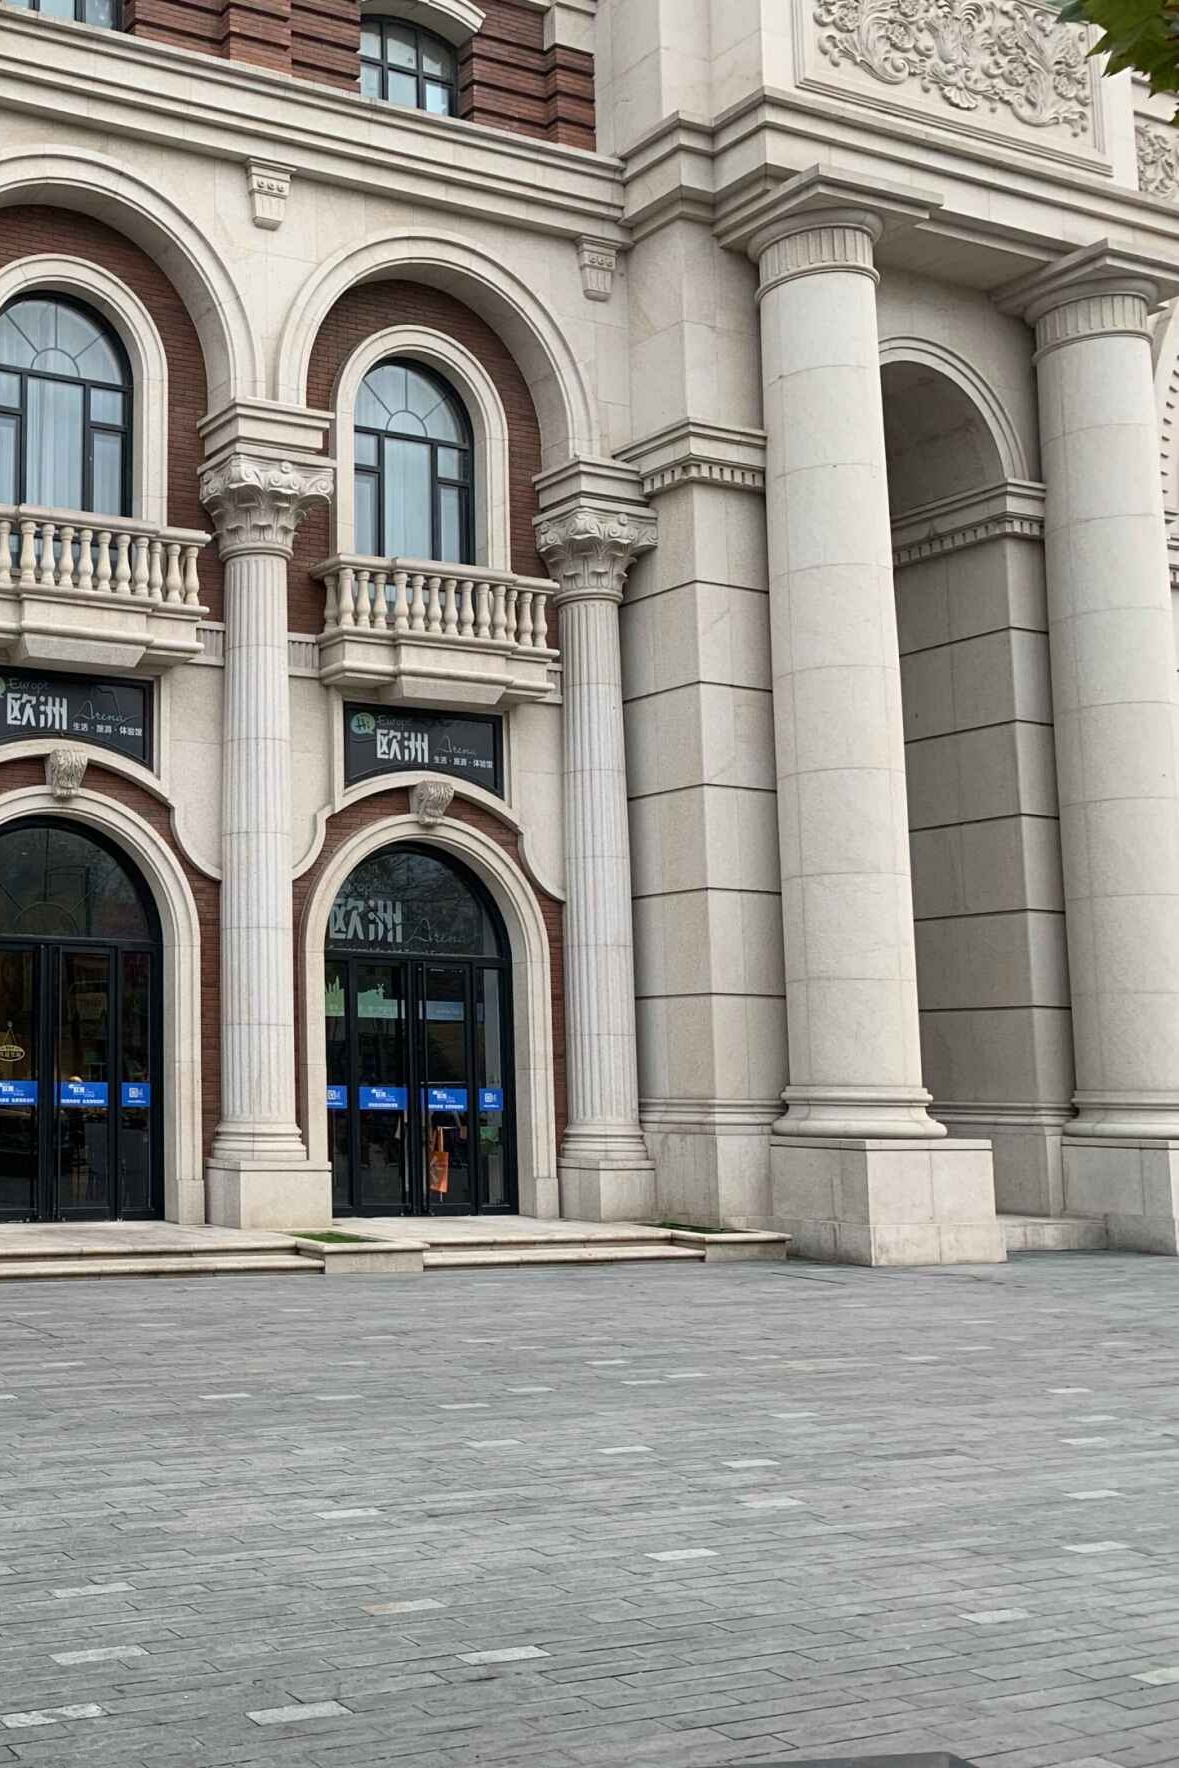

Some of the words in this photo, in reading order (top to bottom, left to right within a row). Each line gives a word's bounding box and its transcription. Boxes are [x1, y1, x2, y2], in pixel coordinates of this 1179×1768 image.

[6, 692, 67, 730] 欧洲
[376, 729, 429, 763] 欧洲
[329, 898, 403, 943] 欧洲
